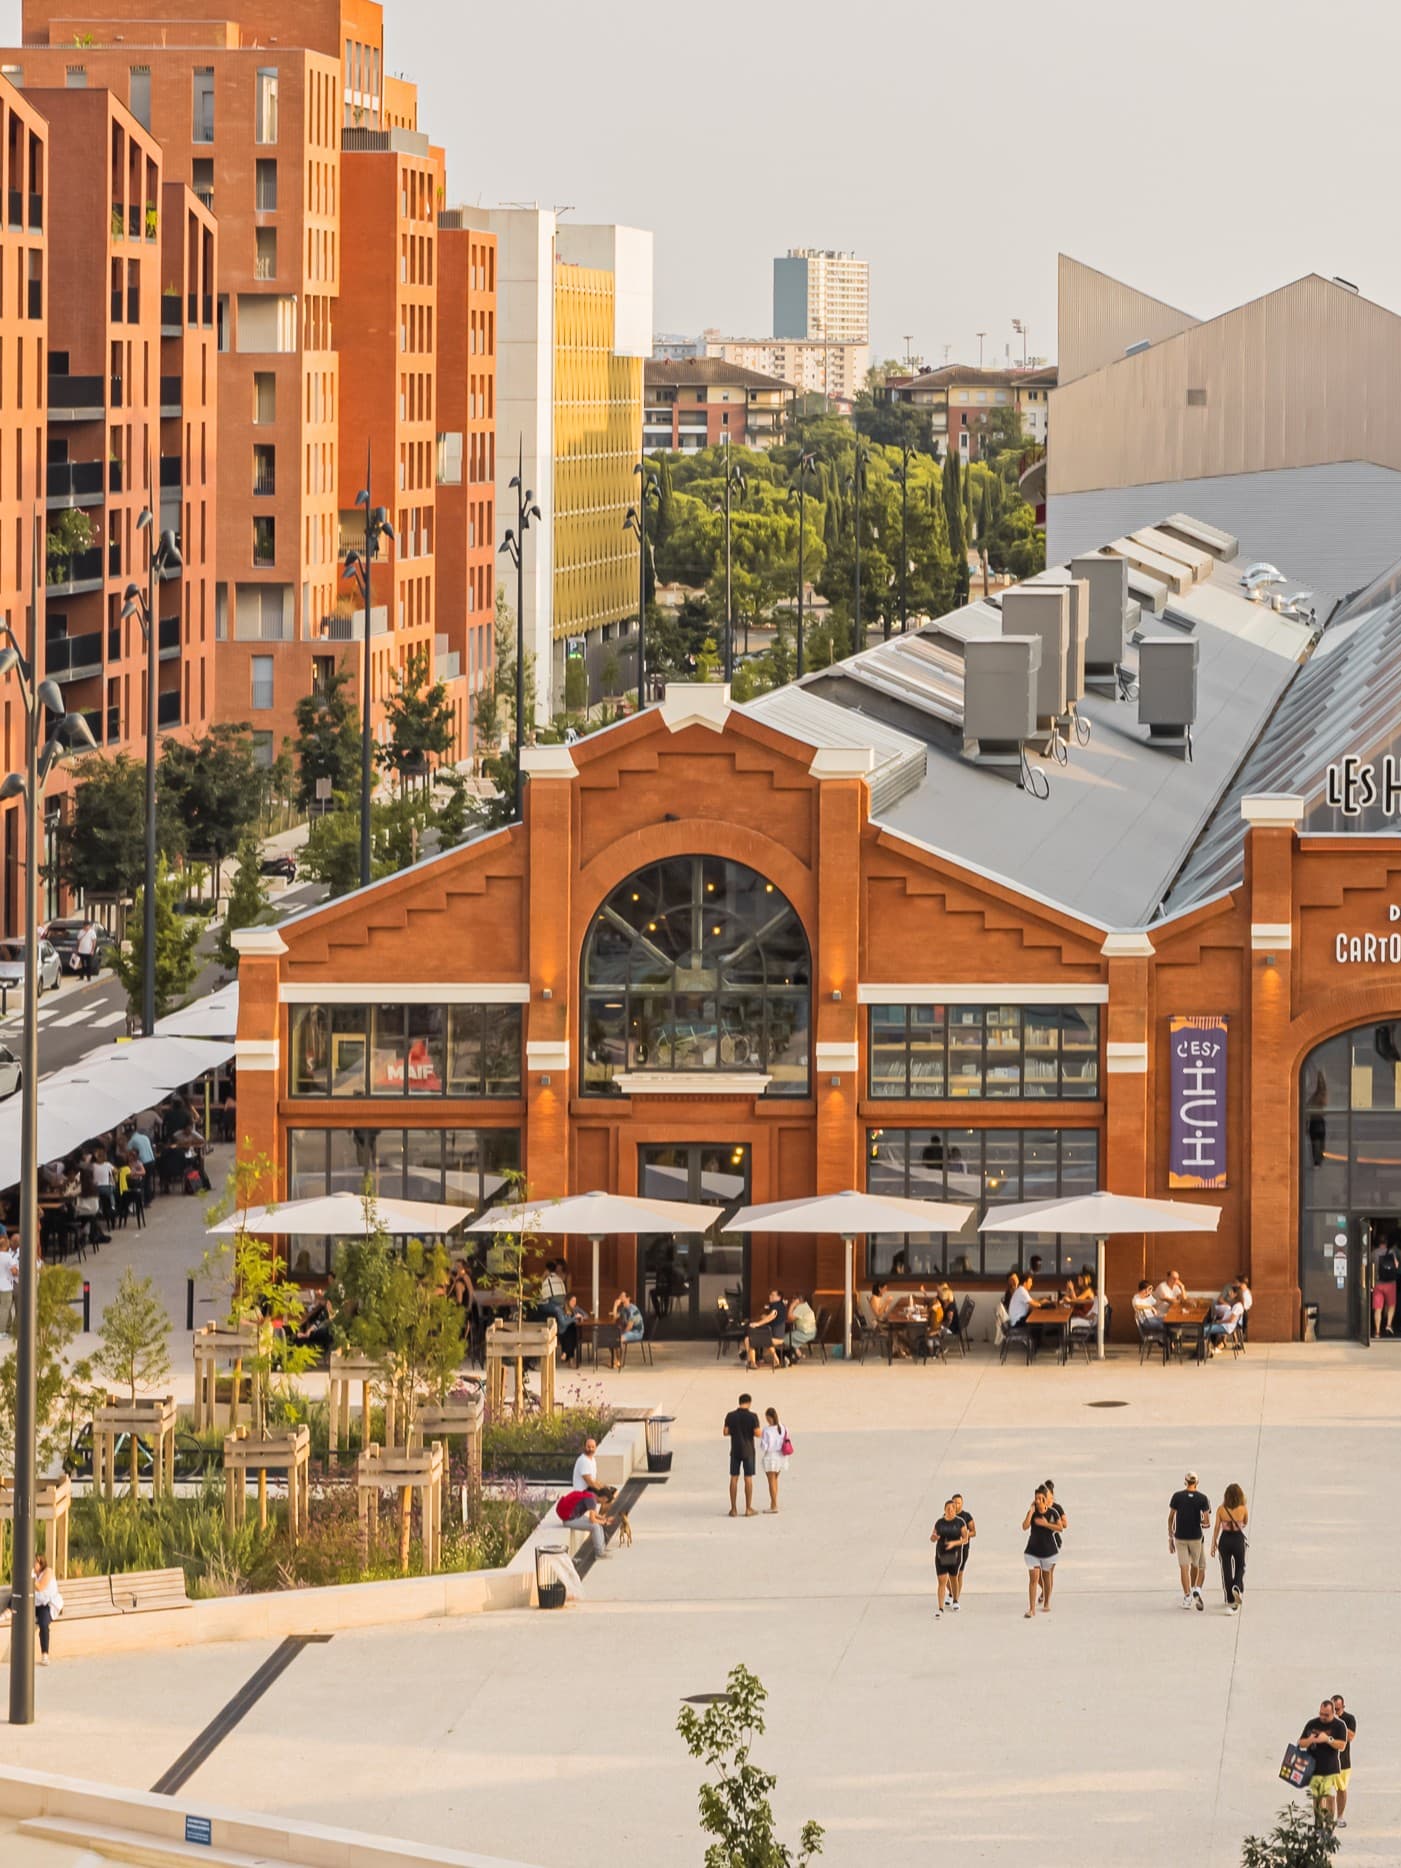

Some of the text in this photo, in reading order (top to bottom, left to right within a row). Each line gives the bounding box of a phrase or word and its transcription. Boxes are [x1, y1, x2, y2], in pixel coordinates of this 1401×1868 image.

[1328, 756, 1375, 814] LES
[1177, 1040, 1221, 1058] C'EST
[388, 1064, 434, 1080] MAIF
